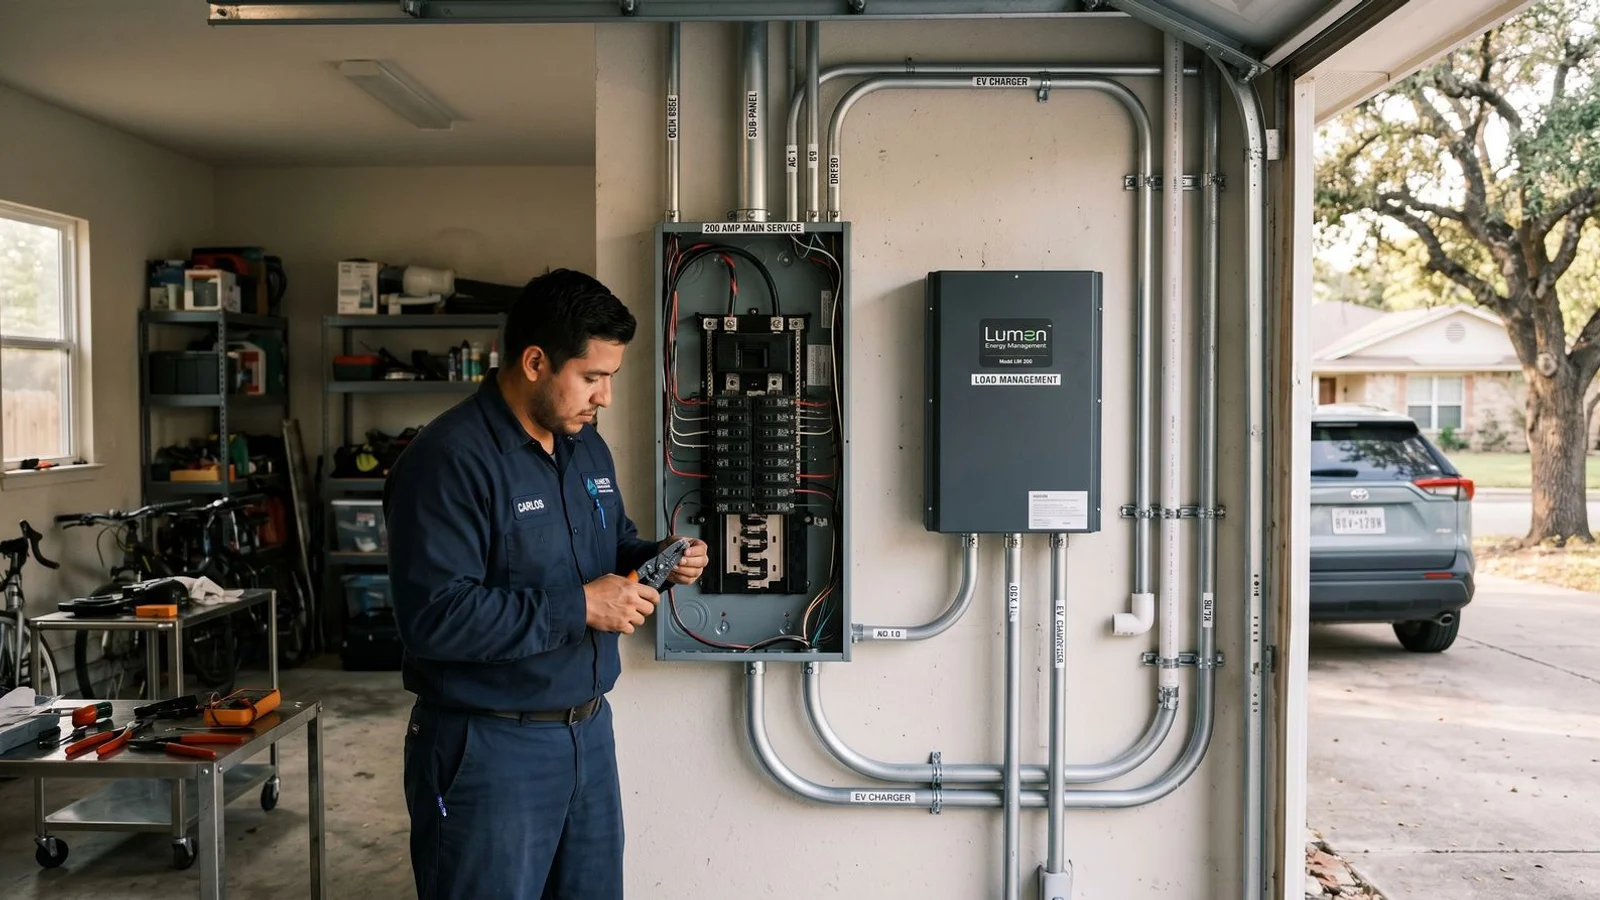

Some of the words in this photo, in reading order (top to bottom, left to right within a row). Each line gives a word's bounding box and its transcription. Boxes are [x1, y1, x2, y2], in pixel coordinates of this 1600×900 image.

[976, 77, 987, 86] EV
[989, 77, 1028, 86] CHARGER
[788, 157, 796, 168] AC
[704, 224, 720, 233] 200
[721, 224, 741, 233] AMP
[742, 224, 765, 233] MAIN
[766, 223, 802, 233] SERVICE
[984, 342, 1006, 350] Energy
[1007, 342, 1047, 350] Management
[975, 375, 997, 384] LOAD
[999, 375, 1059, 384] MANAGEMENT
[517, 499, 545, 513] CARLOS
[1056, 605, 1065, 617] EV
[854, 793, 867, 801] EV
[868, 793, 911, 802] CHARGER
